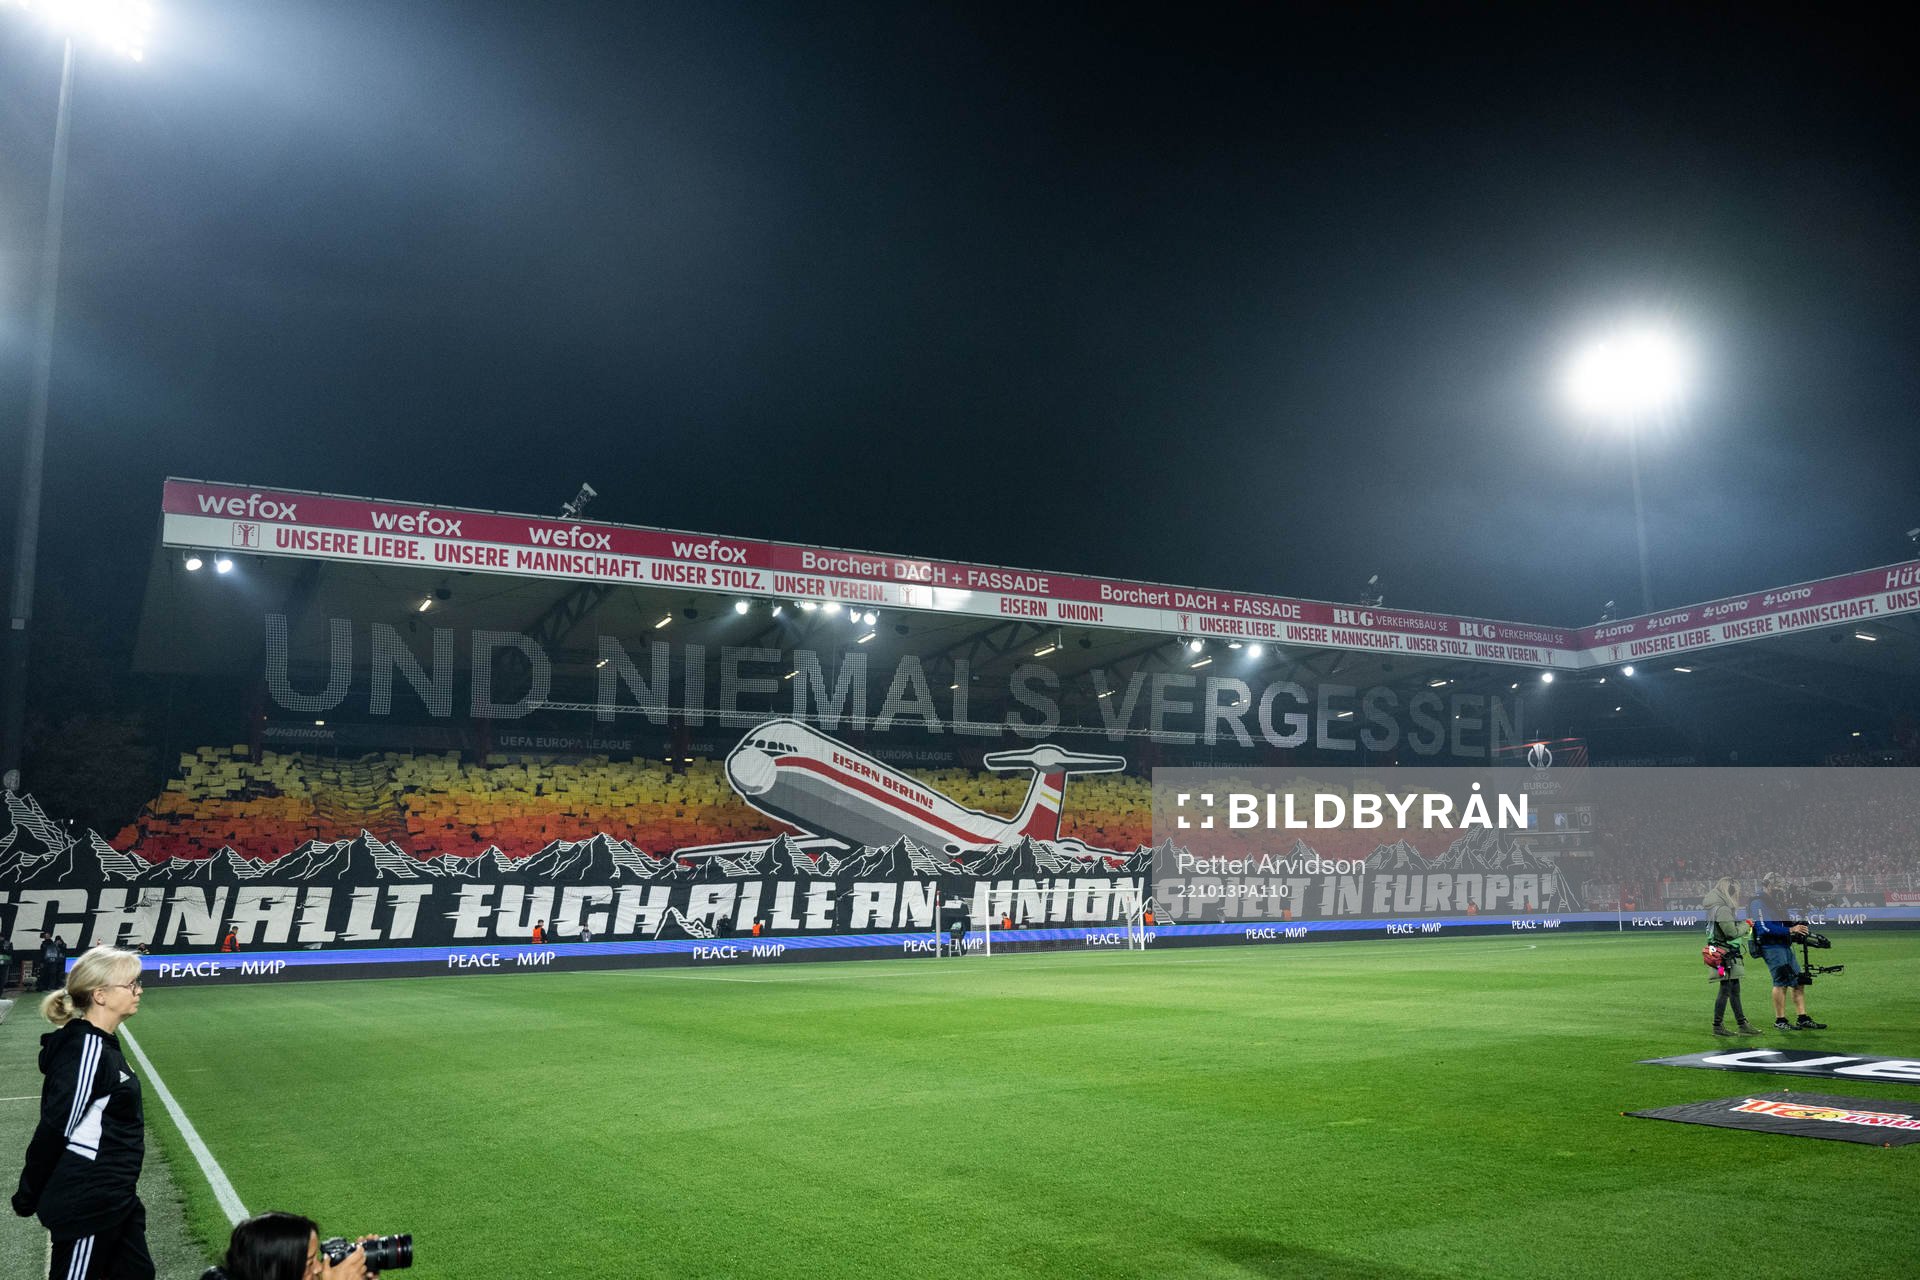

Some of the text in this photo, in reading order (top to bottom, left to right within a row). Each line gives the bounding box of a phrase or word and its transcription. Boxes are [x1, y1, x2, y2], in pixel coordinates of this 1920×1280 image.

[197, 493, 296, 521] wefox
[371, 511, 462, 537] wefox
[276, 528, 426, 561] UNSERE LIEBE.
[528, 526, 611, 550] wefox
[434, 543, 644, 579] UNSERE MANNSCHAFT.
[672, 540, 747, 564] wefox
[652, 564, 766, 590] UNSER STOLZ.
[802, 551, 1050, 593] Borchert DACH + FASSADE
[774, 575, 888, 602] UNSER VEREIN.
[1776, 587, 1812, 603] LOTTO
[1886, 588, 1920, 610] UNS
[1000, 597, 1104, 622] EISERN UNION!
[1100, 583, 1302, 619] Borchert DACH + FASSADE
[1715, 600, 1748, 615] LOTTO
[1199, 616, 1280, 639] UNSERE LIEBE.
[1333, 608, 1448, 632] BUG VERKEHRSBAU SE
[1605, 623, 1634, 637] LOTTO
[1658, 613, 1690, 627] LOTTO
[1723, 598, 1879, 640] UNSERE MANNSCHAFT.
[1287, 625, 1403, 649] UNSERE MANNSCHAFT.
[1459, 621, 1564, 644] BUG VERKEHRSBAU SE
[1630, 629, 1716, 656] UNSERE LIEBE.
[1406, 636, 1471, 656] UNSER STOLZ.
[1474, 643, 1541, 662] UNSER VEREIN.
[265, 613, 1526, 758] UND NIEMALS VERGESSEN
[501, 735, 632, 750] UEFA EUROPA LEAGUE
[832, 751, 934, 810] EISERN BERLIN!
[0, 884, 432, 951] CHNALLT
[443, 883, 671, 939] EUCH
[686, 881, 836, 931] ALLE
[846, 881, 938, 929] AN
[1320, 875, 1364, 916] IN
[1512, 920, 1537, 929] PEACE
[1543, 919, 1561, 928] МИР
[1632, 917, 1663, 926] PEACE
[1673, 916, 1697, 926] МИР
[1838, 913, 1867, 925] МИР
[1086, 933, 1121, 945] PEACE
[1246, 928, 1277, 939] PEACE
[1285, 927, 1307, 938] МИР
[1387, 924, 1414, 934] PEACE
[1421, 922, 1442, 933] МИР
[448, 953, 500, 968] PEACE
[517, 951, 556, 966] МИР
[693, 946, 738, 959] PEACE
[752, 943, 785, 958] МИР
[159, 962, 220, 978] PEACE
[241, 959, 286, 975] МИР
